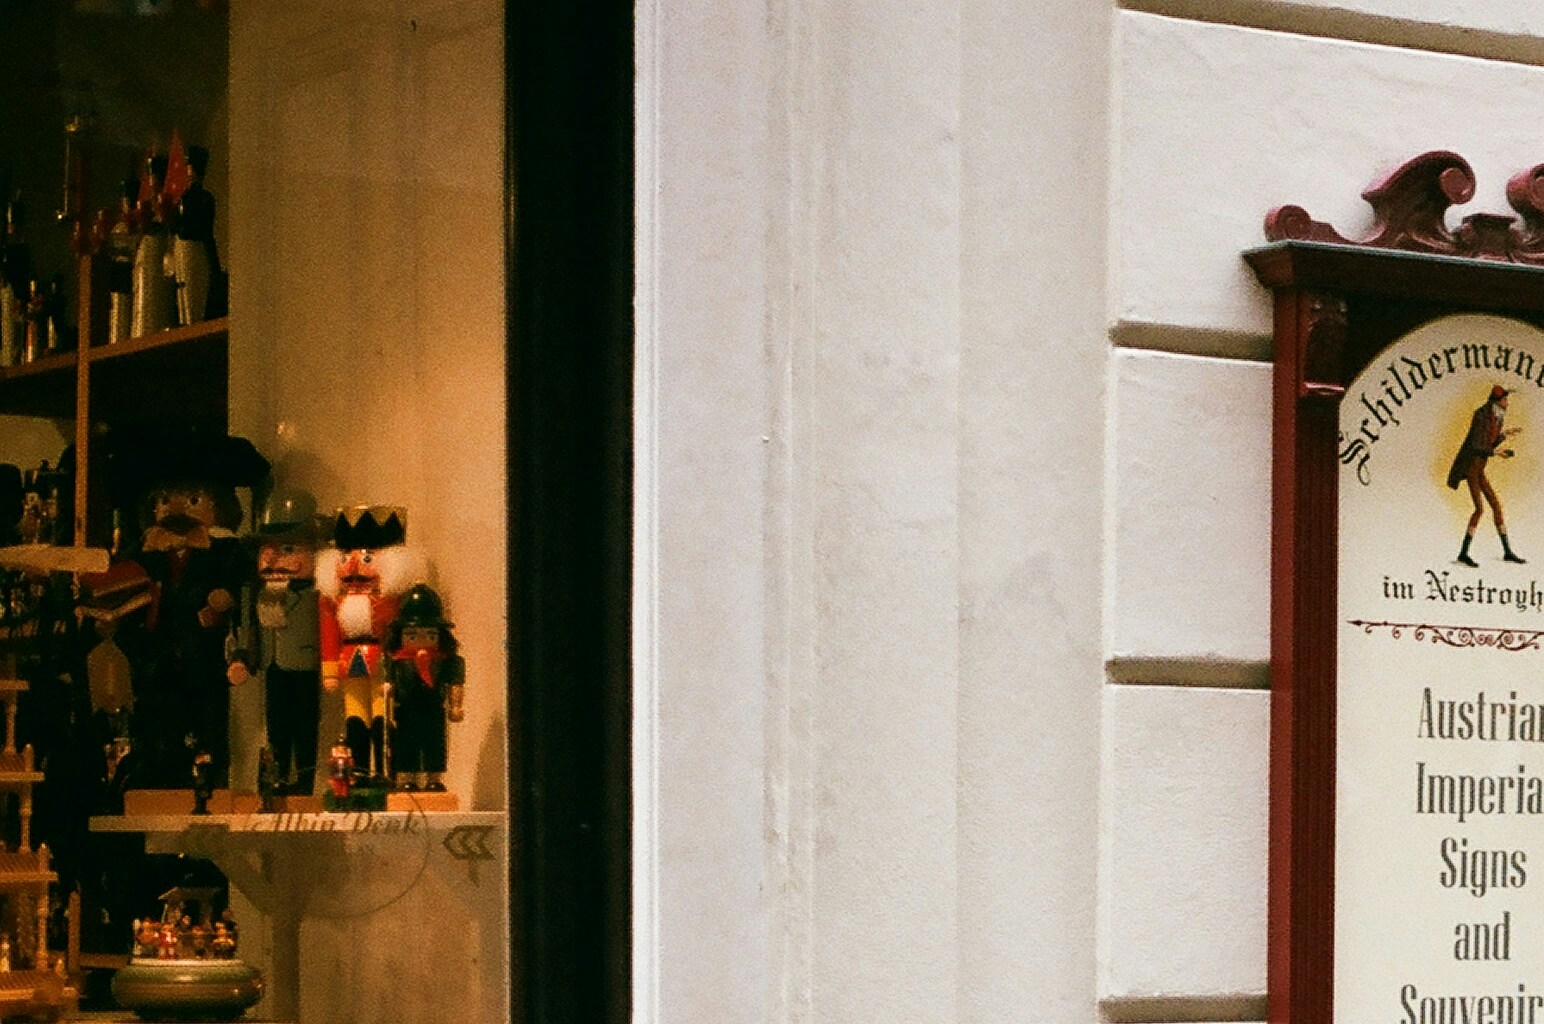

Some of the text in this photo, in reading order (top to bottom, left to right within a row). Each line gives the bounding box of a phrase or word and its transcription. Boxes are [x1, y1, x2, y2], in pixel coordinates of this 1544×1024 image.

[1383, 575, 1415, 599] im
[1440, 837, 1528, 898] Signs
[1453, 911, 1512, 961] and
